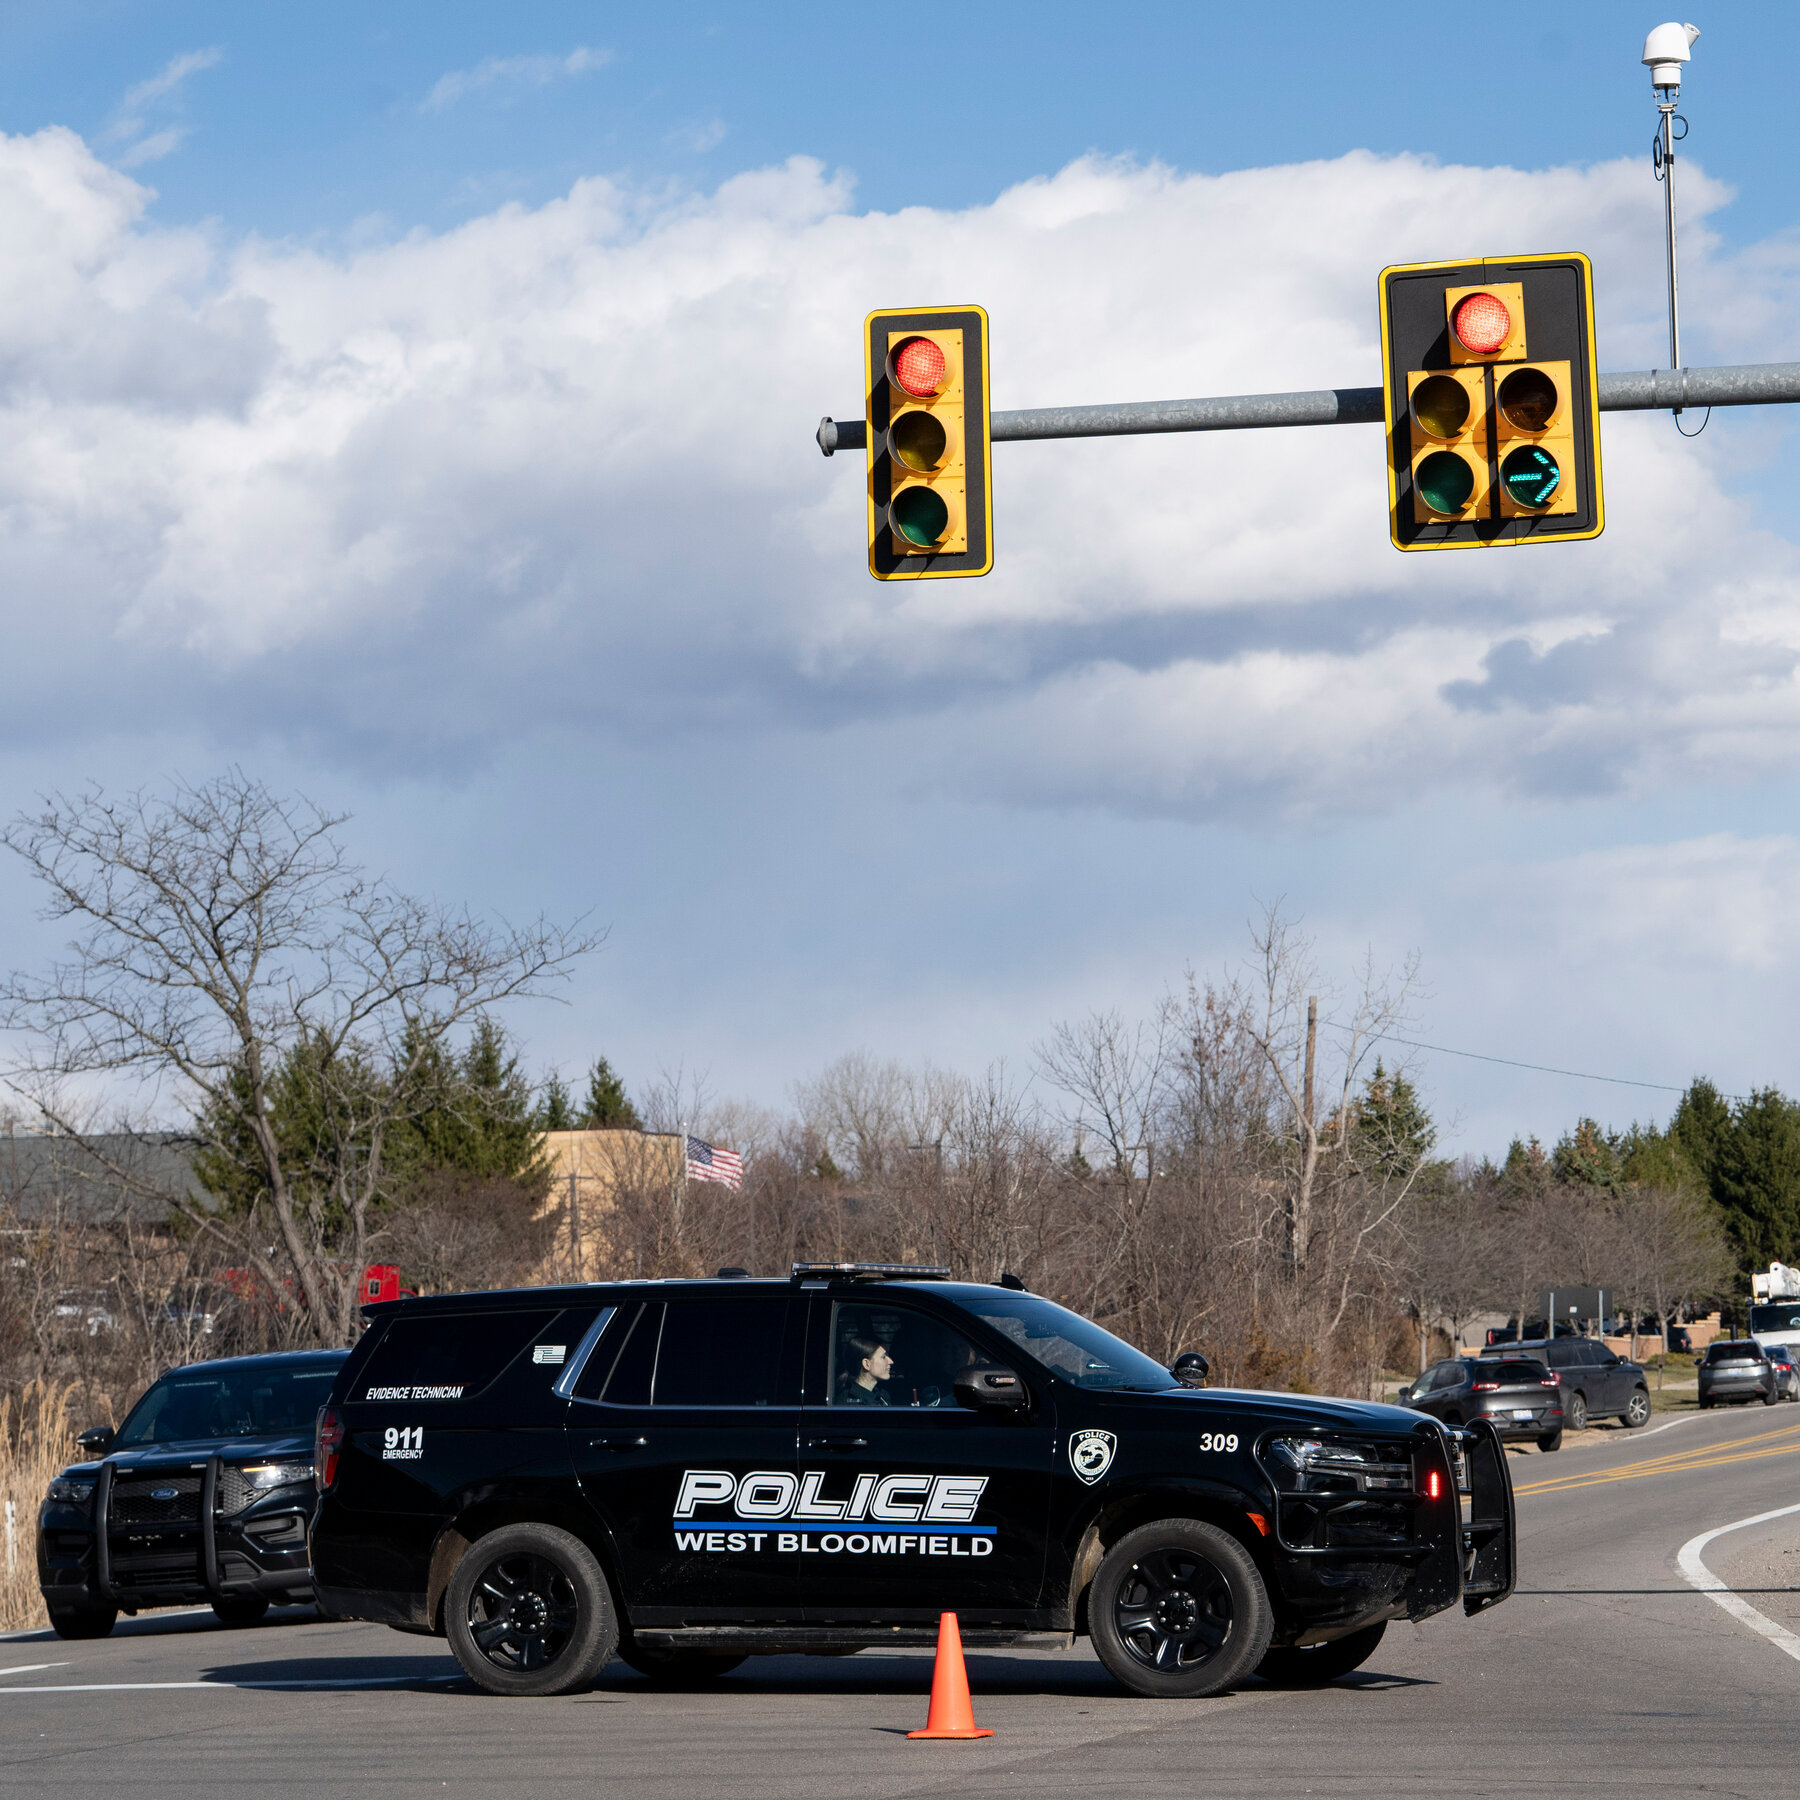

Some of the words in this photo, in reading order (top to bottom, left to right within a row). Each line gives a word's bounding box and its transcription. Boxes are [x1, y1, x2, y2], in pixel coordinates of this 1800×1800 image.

[366, 1387, 410, 1399] EVIDENCE
[411, 1386, 463, 1398] TECHNICIAN
[385, 1427, 423, 1449] 911
[1078, 1431, 1111, 1442] POLICE
[1200, 1433, 1238, 1452] 309
[383, 1450, 423, 1460] EMERGENCY
[673, 1470, 989, 1521] POLICE
[675, 1533, 767, 1551] WEST
[778, 1534, 993, 1555] BLOOMFIELD
